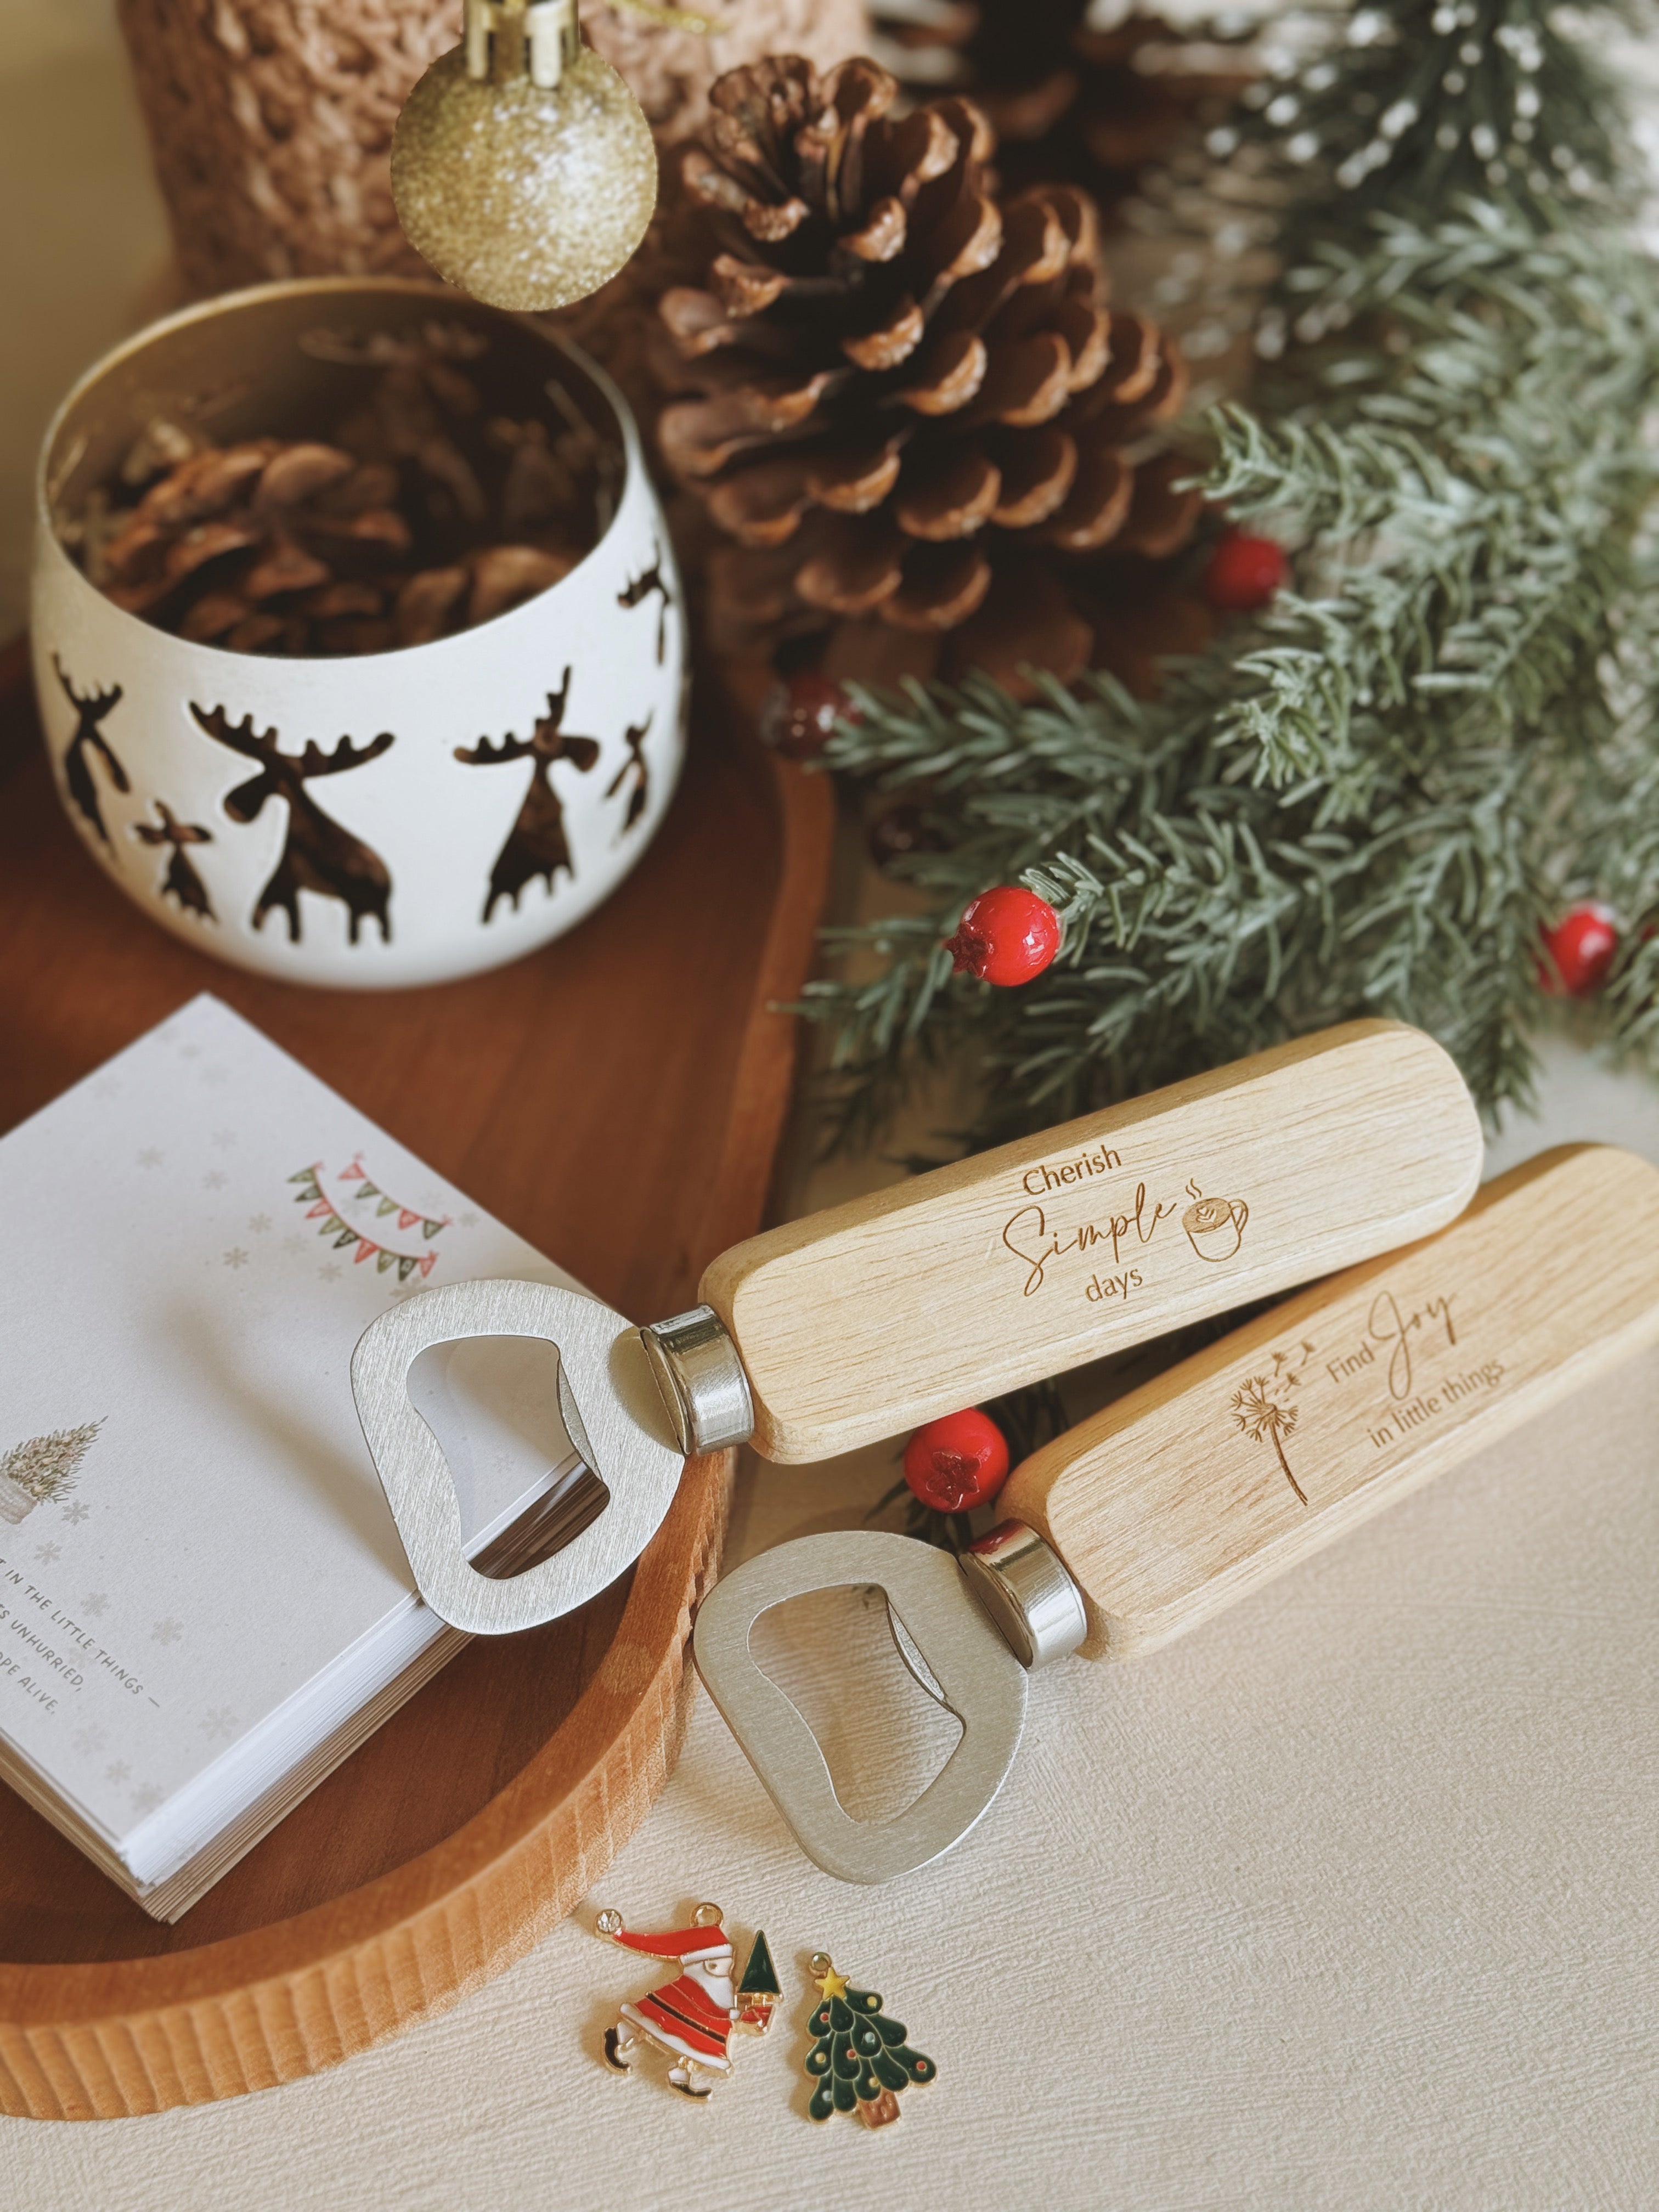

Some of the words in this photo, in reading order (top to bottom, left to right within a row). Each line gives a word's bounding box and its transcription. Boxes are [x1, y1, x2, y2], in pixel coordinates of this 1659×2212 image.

[1023, 1145, 1122, 1195] Cherish
[1003, 1182, 1177, 1297] Simple
[1085, 1268, 1143, 1302] days
[1325, 1341, 1376, 1383] Find
[1368, 1290, 1457, 1401] Joy
[1367, 1425, 1394, 1448] in
[1391, 1393, 1443, 1433] little
[1441, 1358, 1505, 1404] things
[5, 1569, 24, 1585] IN
[24, 1585, 52, 1610] THE
[51, 1610, 95, 1650] LITTLE
[95, 1649, 144, 1695] THINGS
[10, 1619, 84, 1692] UNHURRIED,
[18, 1677, 59, 1714] ALIVE.
